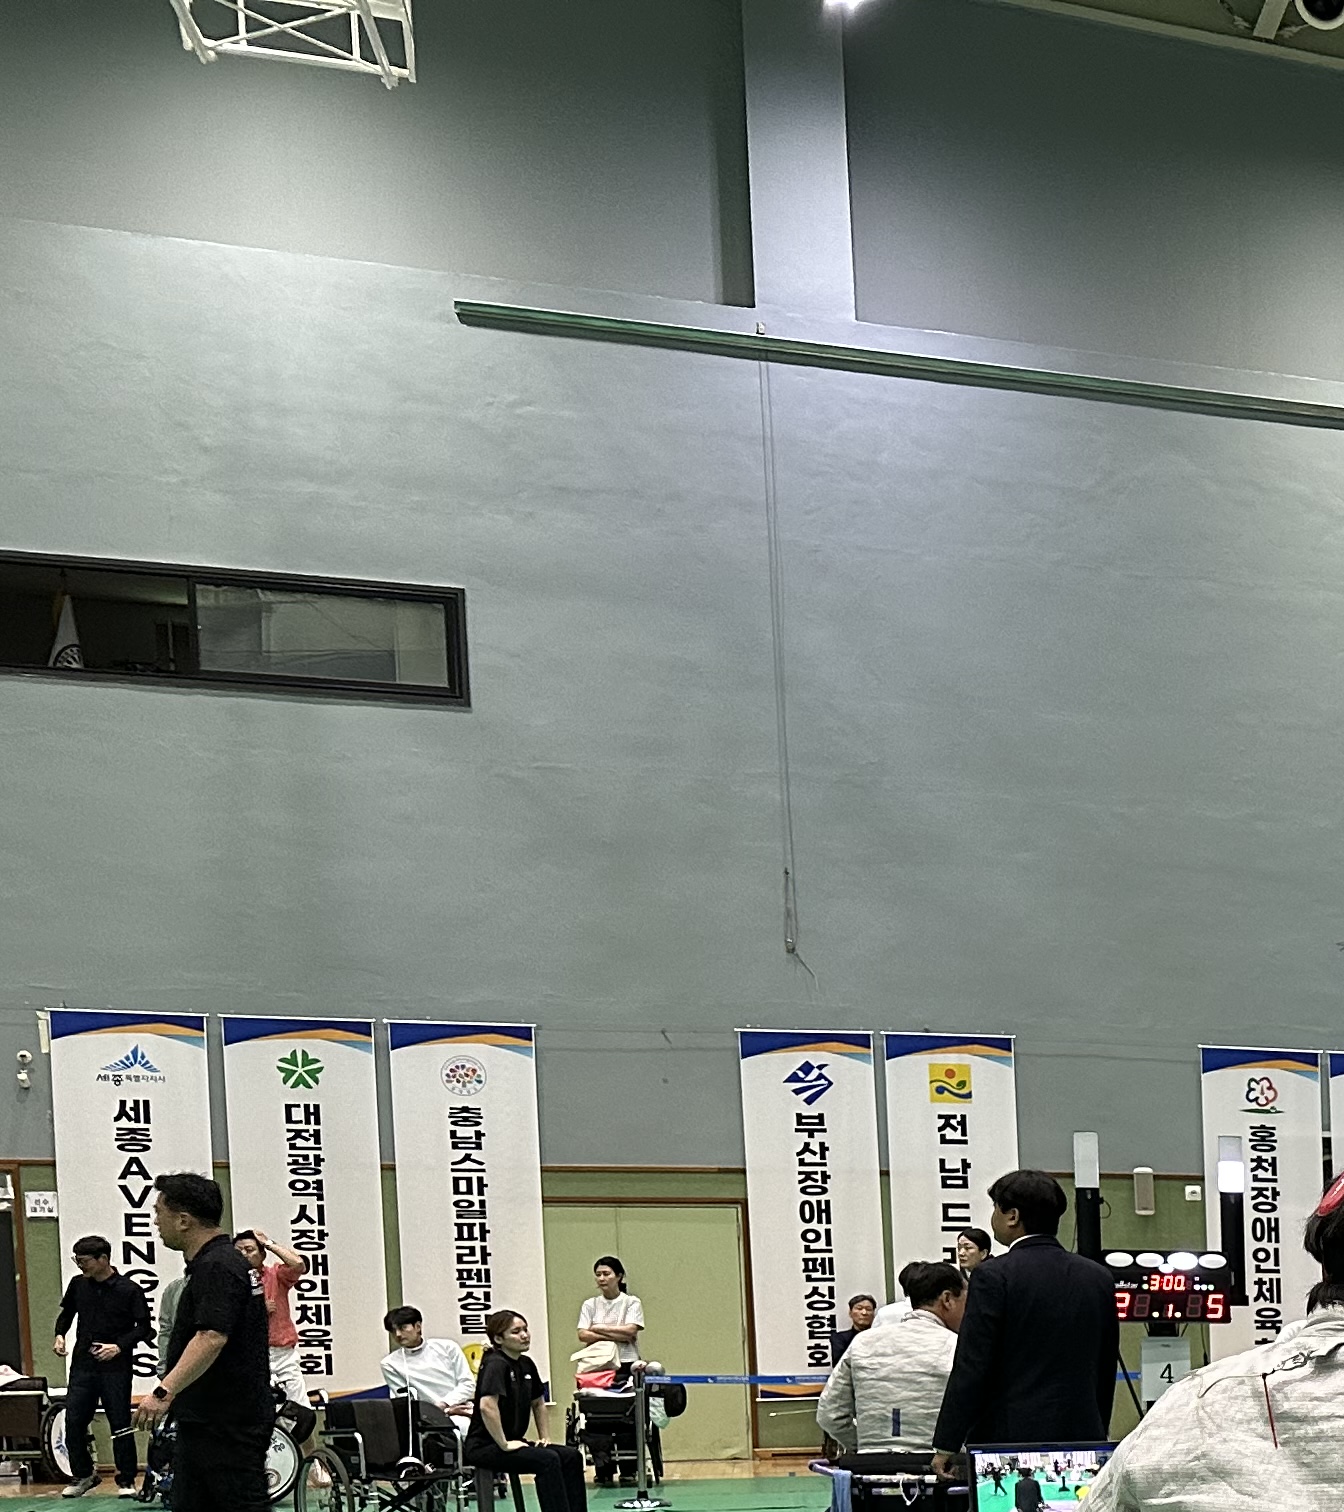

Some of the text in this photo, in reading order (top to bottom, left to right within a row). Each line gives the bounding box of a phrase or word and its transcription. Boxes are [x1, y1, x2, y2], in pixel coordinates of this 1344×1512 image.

[284, 1103, 333, 1376] 대전광역시장애인체육회
[1248, 1123, 1283, 1346] 홍천장애인체육
[1206, 1294, 1224, 1319] 5
[1160, 1363, 1174, 1383] 4
